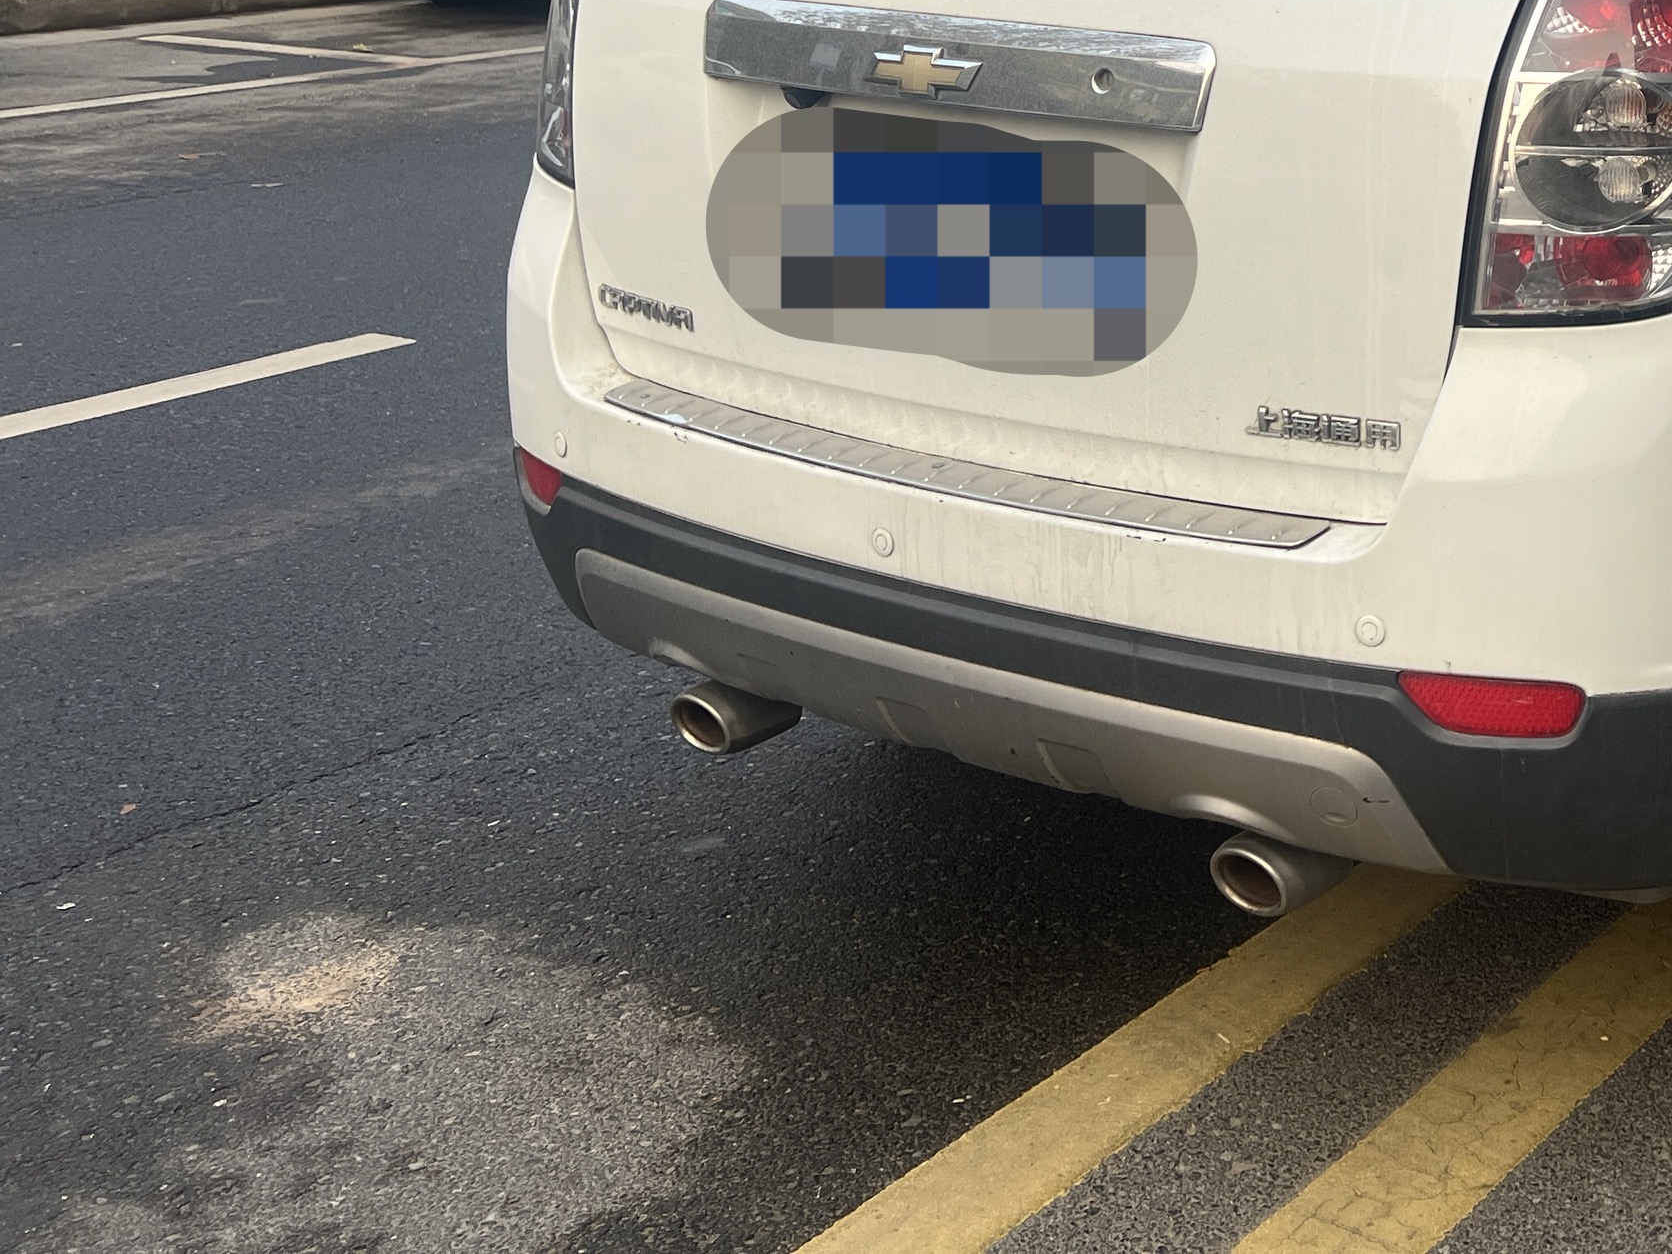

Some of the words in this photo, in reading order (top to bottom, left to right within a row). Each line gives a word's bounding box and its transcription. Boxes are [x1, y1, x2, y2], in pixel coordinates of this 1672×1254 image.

[598, 283, 695, 332] CAPTIVA
[1245, 405, 1401, 451] 上海通用
